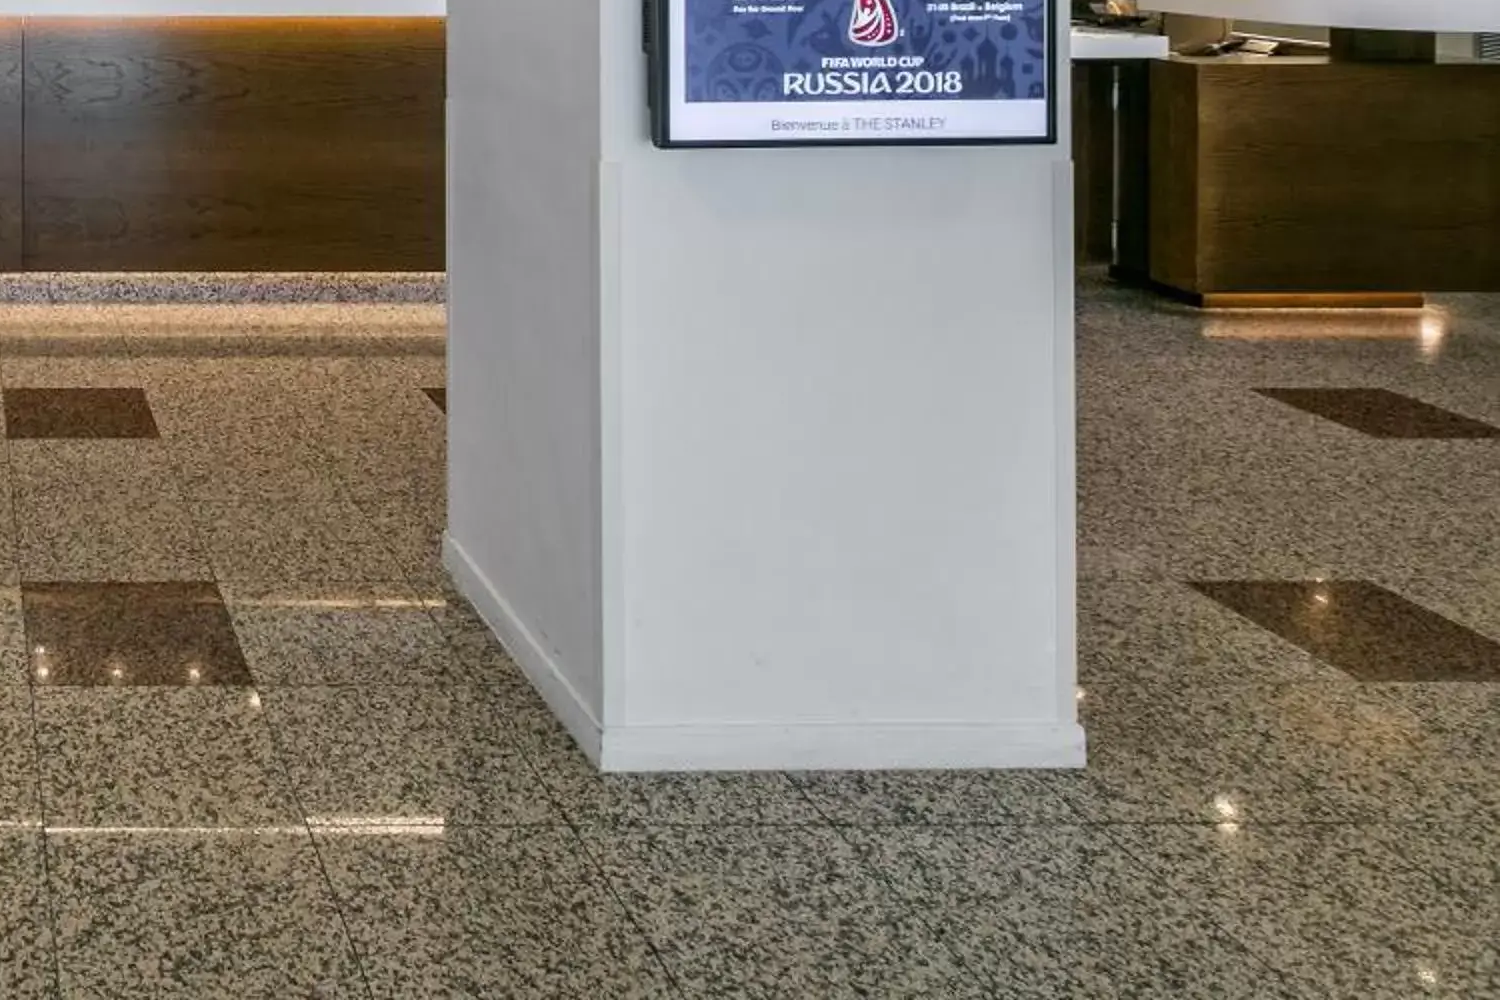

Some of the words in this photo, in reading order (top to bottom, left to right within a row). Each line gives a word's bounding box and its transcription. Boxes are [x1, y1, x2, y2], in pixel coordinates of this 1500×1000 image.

[821, 57, 850, 69] FIFA
[849, 56, 897, 69] WORLD
[899, 56, 924, 68] CUP
[783, 72, 892, 95] RUSSIA
[895, 71, 963, 94] 2018
[771, 120, 839, 132] Bienvenue
[852, 118, 883, 131] THE
[884, 118, 946, 131] STANLEY
